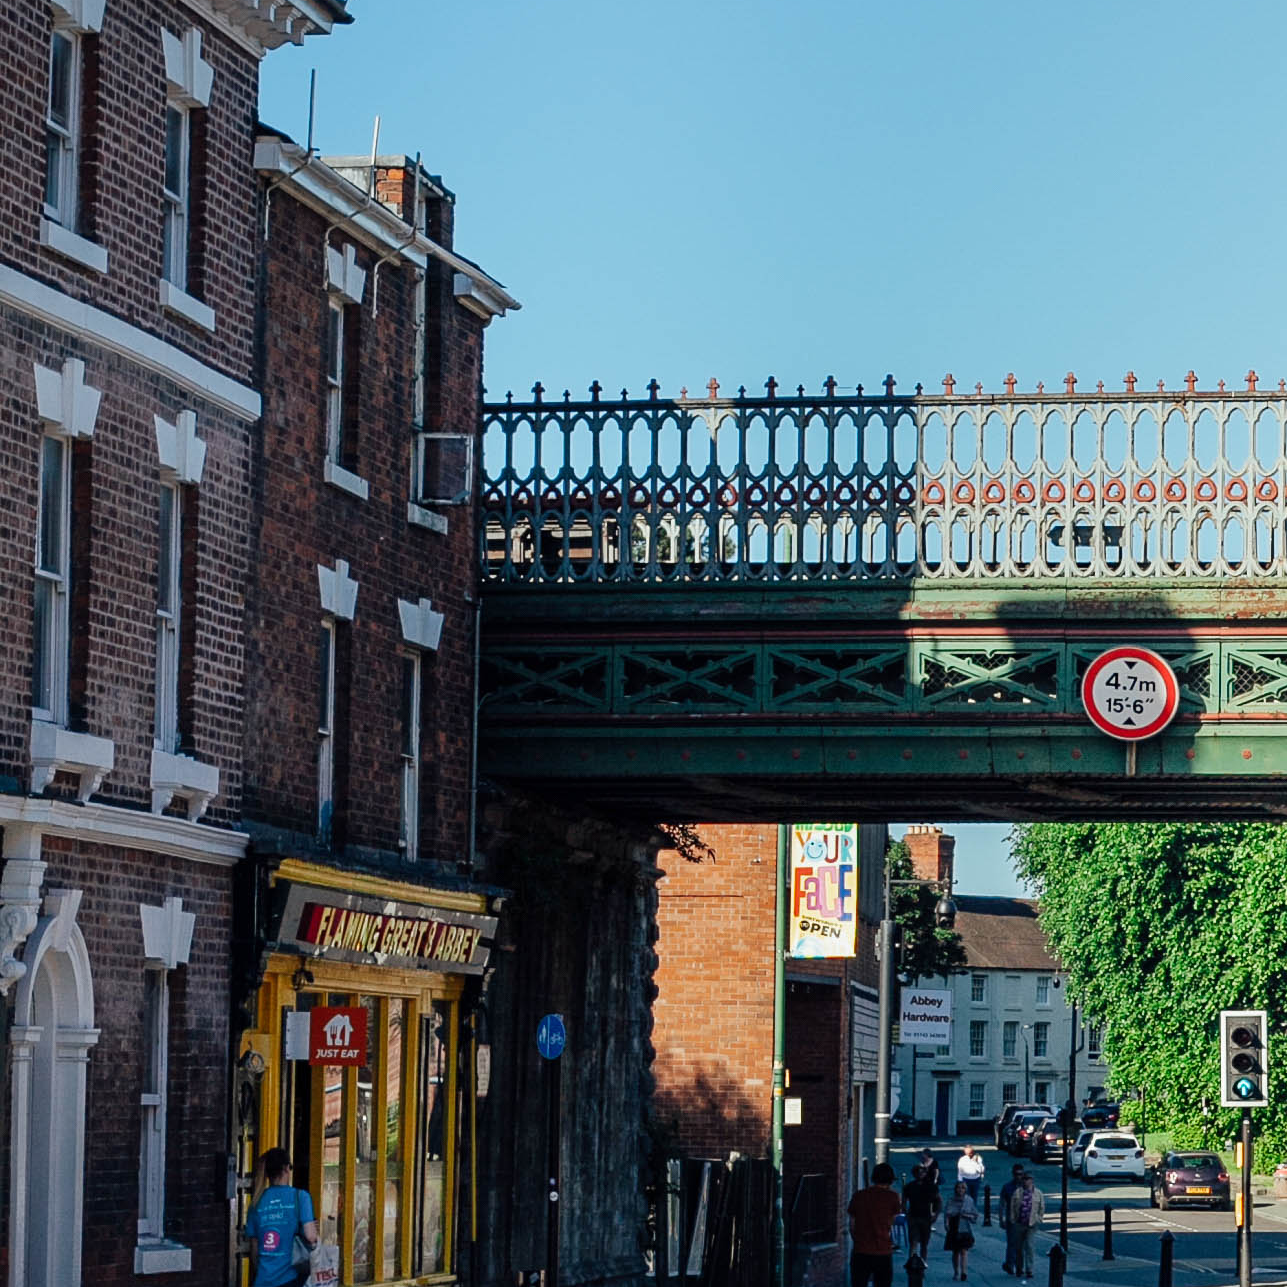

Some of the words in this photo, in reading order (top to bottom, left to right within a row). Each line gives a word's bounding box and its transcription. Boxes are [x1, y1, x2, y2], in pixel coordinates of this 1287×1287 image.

[1105, 672, 1156, 693] 4.7m
[315, 906, 382, 954] FLAMING
[380, 917, 429, 957] GREAT
[432, 924, 481, 964] ABBEY
[799, 920, 841, 939] OPEN
[911, 995, 943, 1009] Abbey
[903, 1011, 950, 1023] Hardware
[315, 1048, 339, 1059] JUST
[340, 1049, 360, 1058] EAT
[264, 1233, 275, 1245] 3
